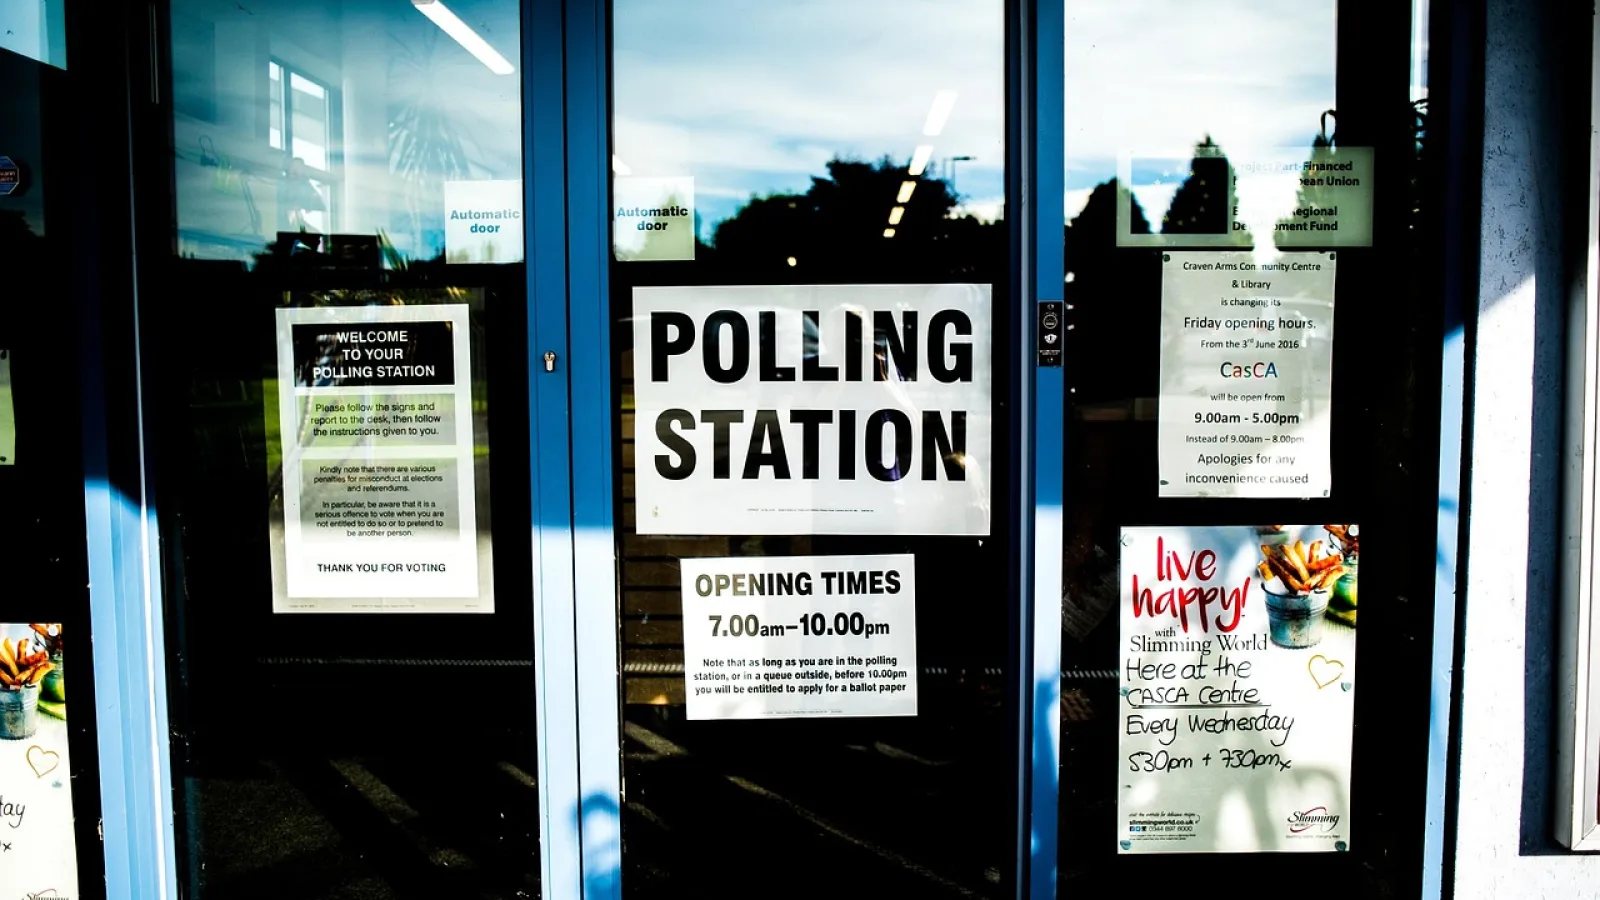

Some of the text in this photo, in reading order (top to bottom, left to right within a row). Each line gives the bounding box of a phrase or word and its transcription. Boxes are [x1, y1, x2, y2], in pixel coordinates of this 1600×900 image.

[1326, 176, 1360, 186] Union
[450, 209, 521, 220] Automatic
[617, 206, 689, 218] Automatic
[469, 223, 501, 234] door
[637, 220, 668, 231] door
[1309, 221, 1338, 231] Fund
[1183, 262, 1213, 271] Craven
[1215, 262, 1237, 271] Arms
[1291, 262, 1321, 271] Centre
[1231, 280, 1271, 290] & Library
[1220, 297, 1281, 308] is changing its
[1184, 317, 1316, 331] Friday opening hours.
[337, 330, 408, 343] WELCOME
[650, 308, 973, 384] POLLING
[1201, 340, 1224, 349] From
[1225, 340, 1240, 349] the
[1255, 340, 1276, 349] June
[1277, 340, 1299, 349] 2016
[342, 348, 404, 361] TO YOUR
[313, 365, 435, 379] POLLING STATION
[1220, 361, 1278, 378] CasCA
[1210, 393, 1286, 403] will be open from
[315, 402, 435, 414] Please follow the signs and
[311, 414, 441, 426] report to the desk, then follow
[1194, 412, 1300, 426] 9.00am 5.00pm
[313, 427, 439, 438] the instructions given to you.
[654, 408, 967, 482] STATION
[1186, 435, 1305, 445] Instead of 9.00am 8.00pm
[1197, 453, 1296, 466] Apologies for any
[319, 465, 341, 474] Kindly
[361, 465, 375, 473] that
[376, 465, 395, 473] there
[410, 465, 436, 473] various
[314, 474, 443, 484] penalties for misconduct elections
[1185, 473, 1309, 484] inconvenience caused
[363, 484, 410, 492] referendums.
[331, 501, 365, 510] particular,
[342, 510, 369, 518] offence
[418, 511, 431, 519] you
[407, 520, 434, 528] pretend
[347, 529, 414, 538] be another person.
[1156, 536, 1217, 582] live
[317, 563, 446, 572] THANK YOU FOR VOTING
[695, 570, 901, 597] OPENING TIMES
[1132, 574, 1251, 633] happy!
[1154, 627, 1176, 637] with
[1130, 633, 1268, 655] Slimming World
[703, 656, 897, 668] Note that as long as you are in the polling
[1126, 654, 1252, 682] Here at the
[694, 669, 907, 682] station, in queue outside, before 10.00pm
[695, 682, 906, 696] you will be entitled to apply for ballot paper
[1126, 680, 1261, 707] CASCA Centre
[1126, 709, 1295, 747] Every Wednesday
[1286, 811, 1340, 832] Slimming
